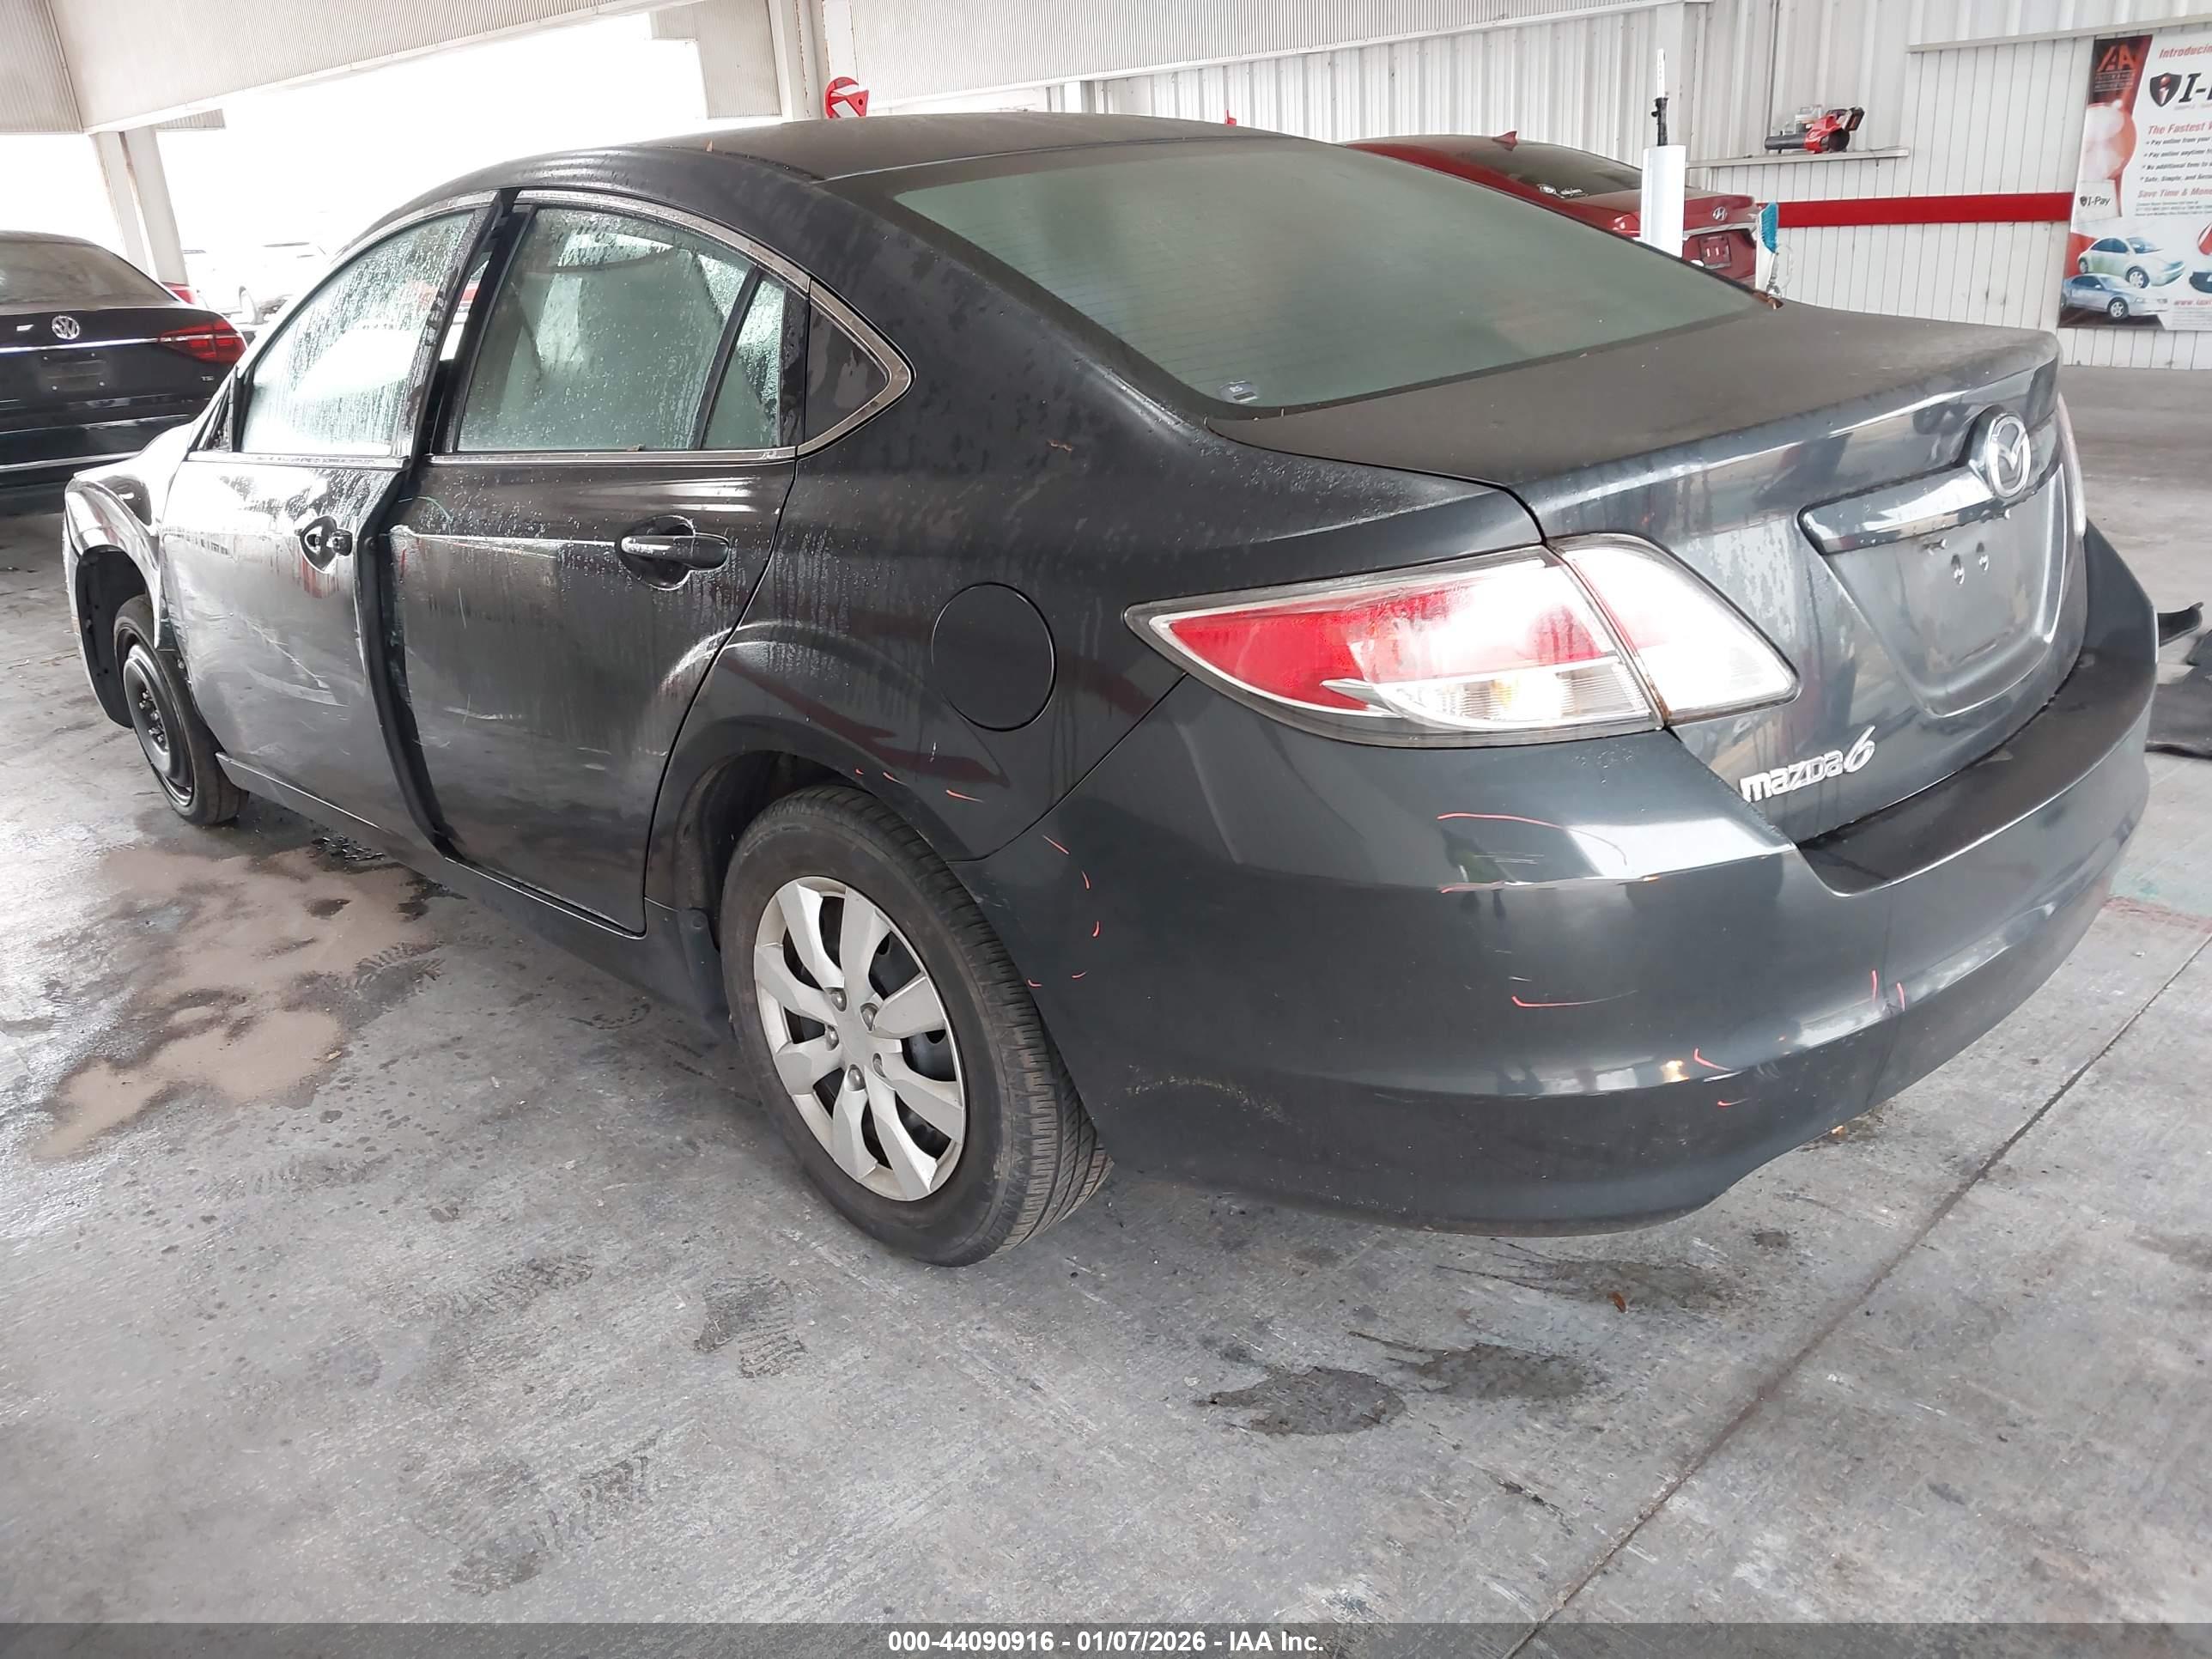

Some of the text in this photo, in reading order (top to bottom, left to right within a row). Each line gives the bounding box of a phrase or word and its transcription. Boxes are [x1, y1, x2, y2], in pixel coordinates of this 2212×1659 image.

[2148, 125, 2165, 135] The
[2167, 123, 2205, 133] Fastest
[2087, 196, 2111, 206] I-Pay
